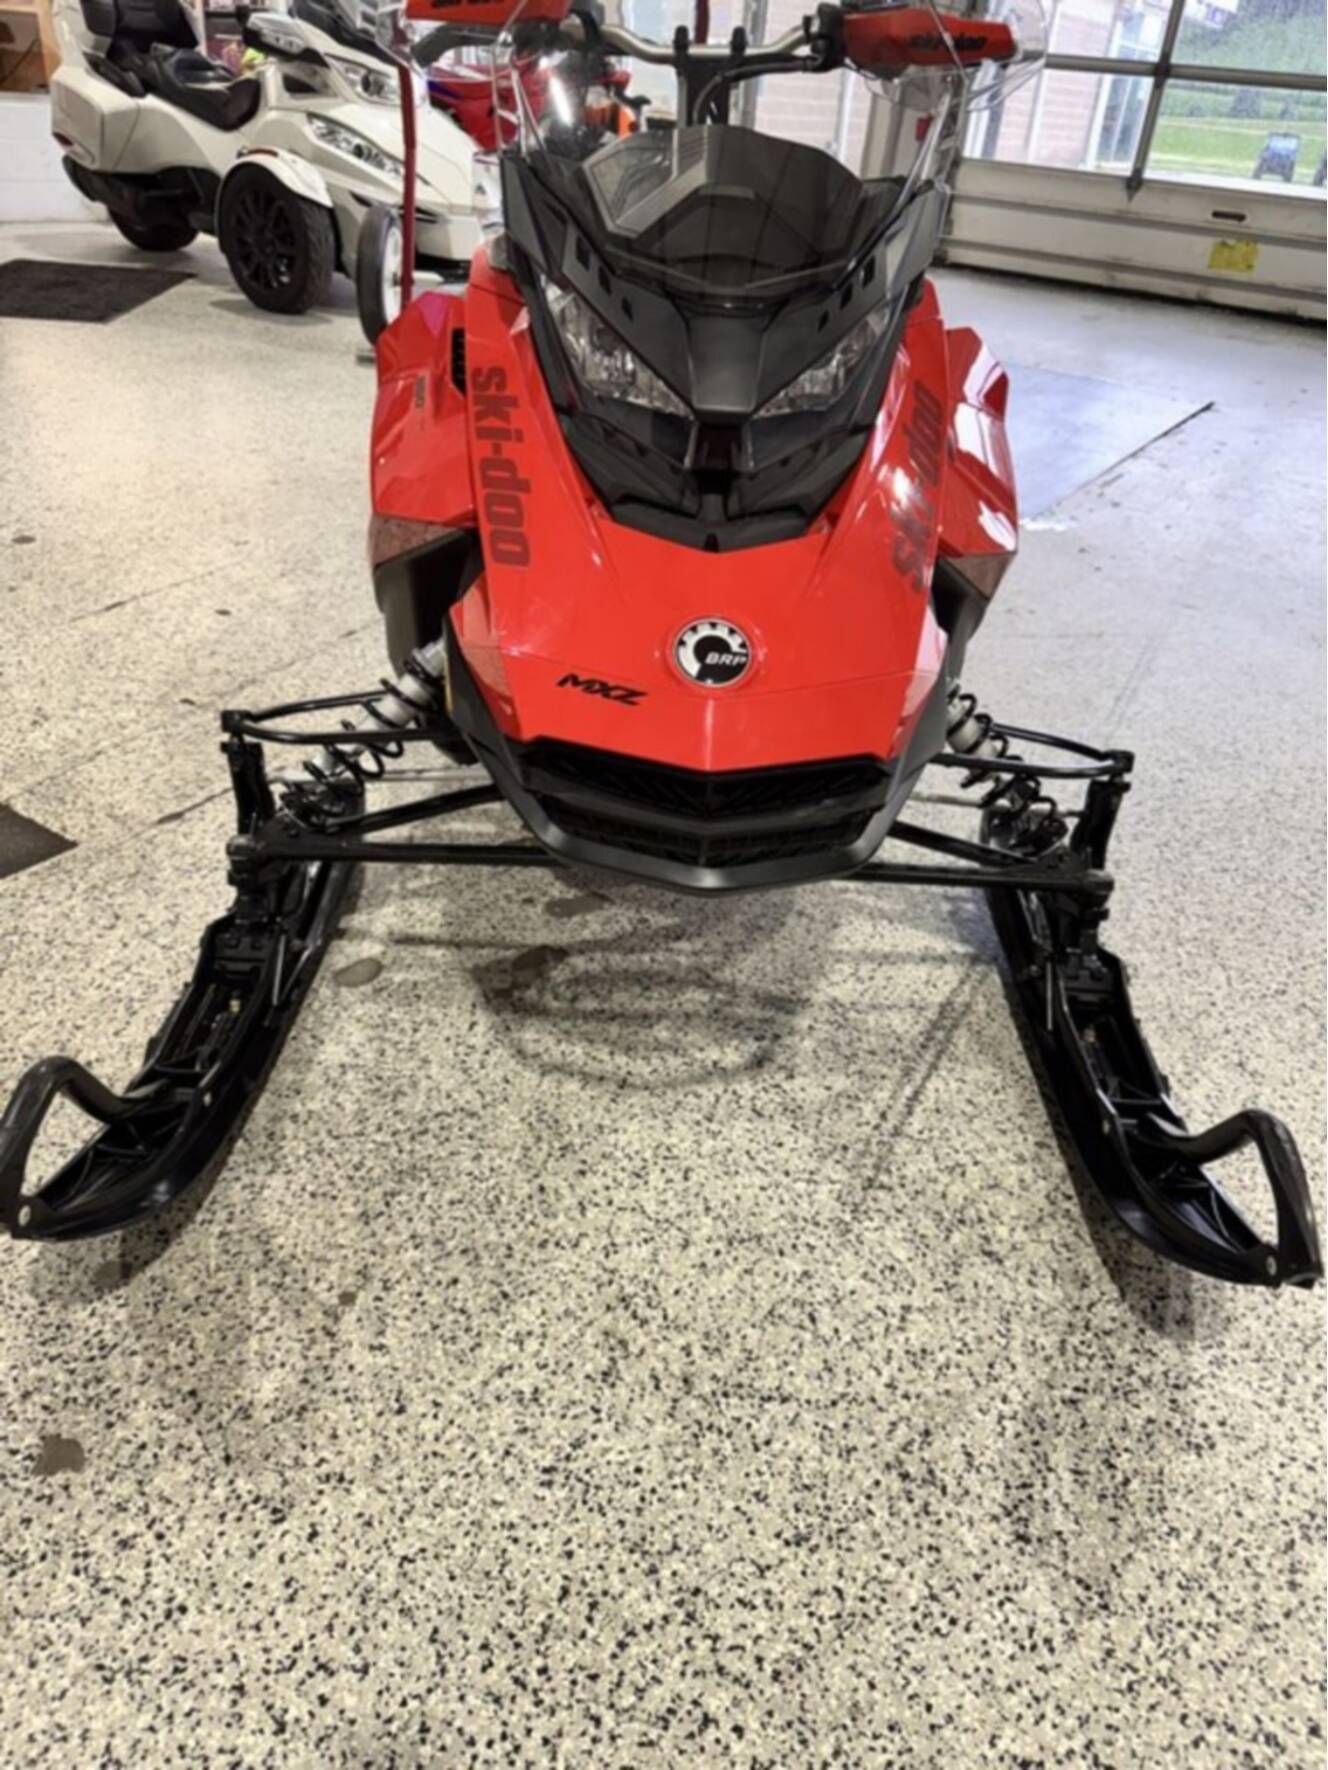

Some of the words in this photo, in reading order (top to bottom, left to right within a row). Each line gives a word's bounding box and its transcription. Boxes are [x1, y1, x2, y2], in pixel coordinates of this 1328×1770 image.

[472, 367, 531, 567] ski-doo
[705, 651, 747, 666] BRP
[557, 672, 647, 706] MXZ
